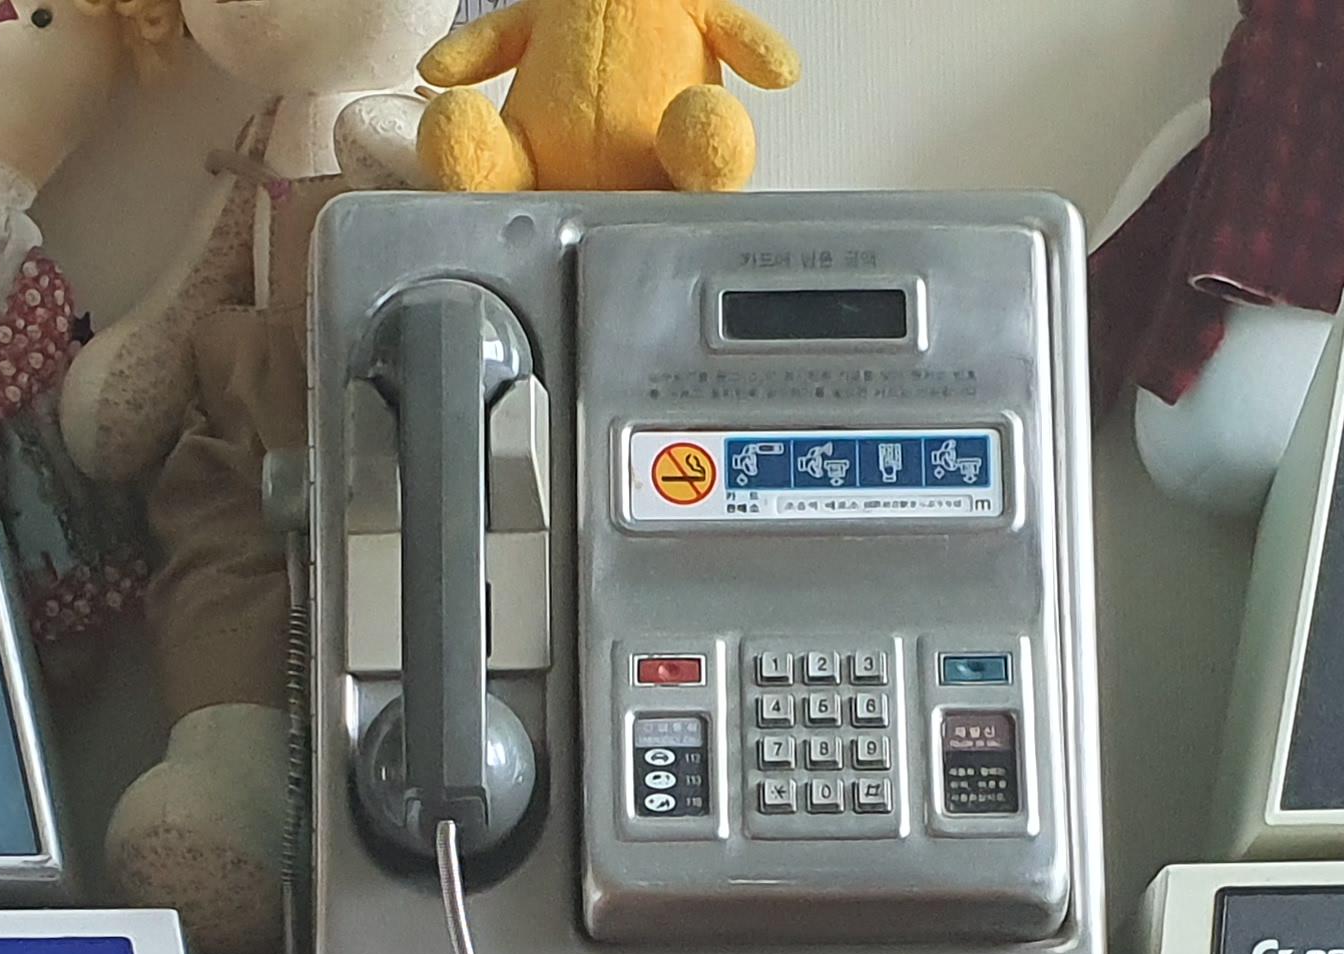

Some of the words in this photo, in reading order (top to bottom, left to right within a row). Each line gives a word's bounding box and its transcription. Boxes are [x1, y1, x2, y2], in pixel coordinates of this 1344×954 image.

[772, 657, 778, 671] 1
[817, 657, 827, 671] 2
[863, 656, 874, 671] 3
[771, 700, 781, 712] 4
[818, 699, 828, 713] 5
[866, 699, 876, 713] 6
[773, 742, 782, 756] 7
[819, 741, 829, 755] 8
[866, 740, 877, 755] 9
[821, 784, 831, 799] 0
